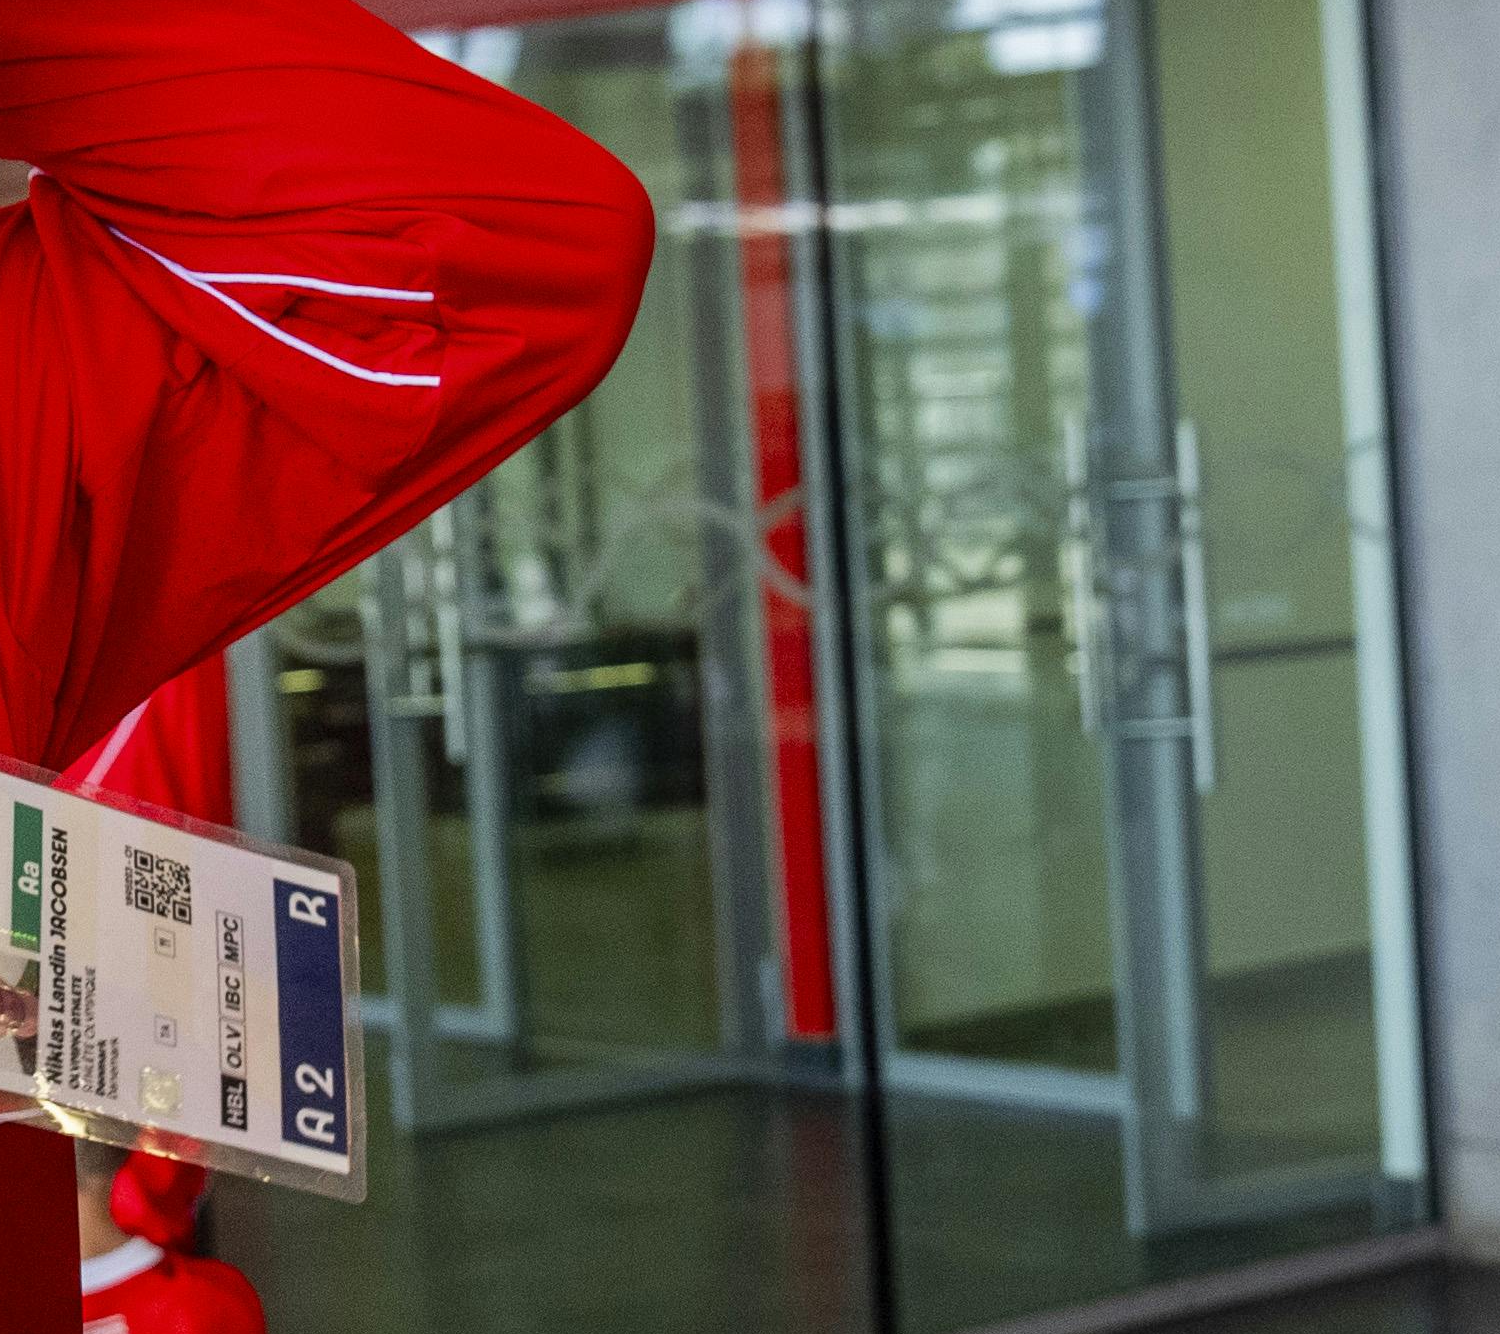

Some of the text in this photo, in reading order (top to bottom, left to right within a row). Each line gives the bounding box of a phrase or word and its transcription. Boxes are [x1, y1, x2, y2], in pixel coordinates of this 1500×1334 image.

[18, 860, 41, 896] Aa
[45, 827, 68, 1085] Niklas Landin JACOBSEN
[222, 916, 241, 963] MPC
[223, 975, 242, 1012] IBC
[224, 1023, 243, 1069] OLV
[294, 1062, 335, 1097] 2
[294, 1107, 337, 1144] A
